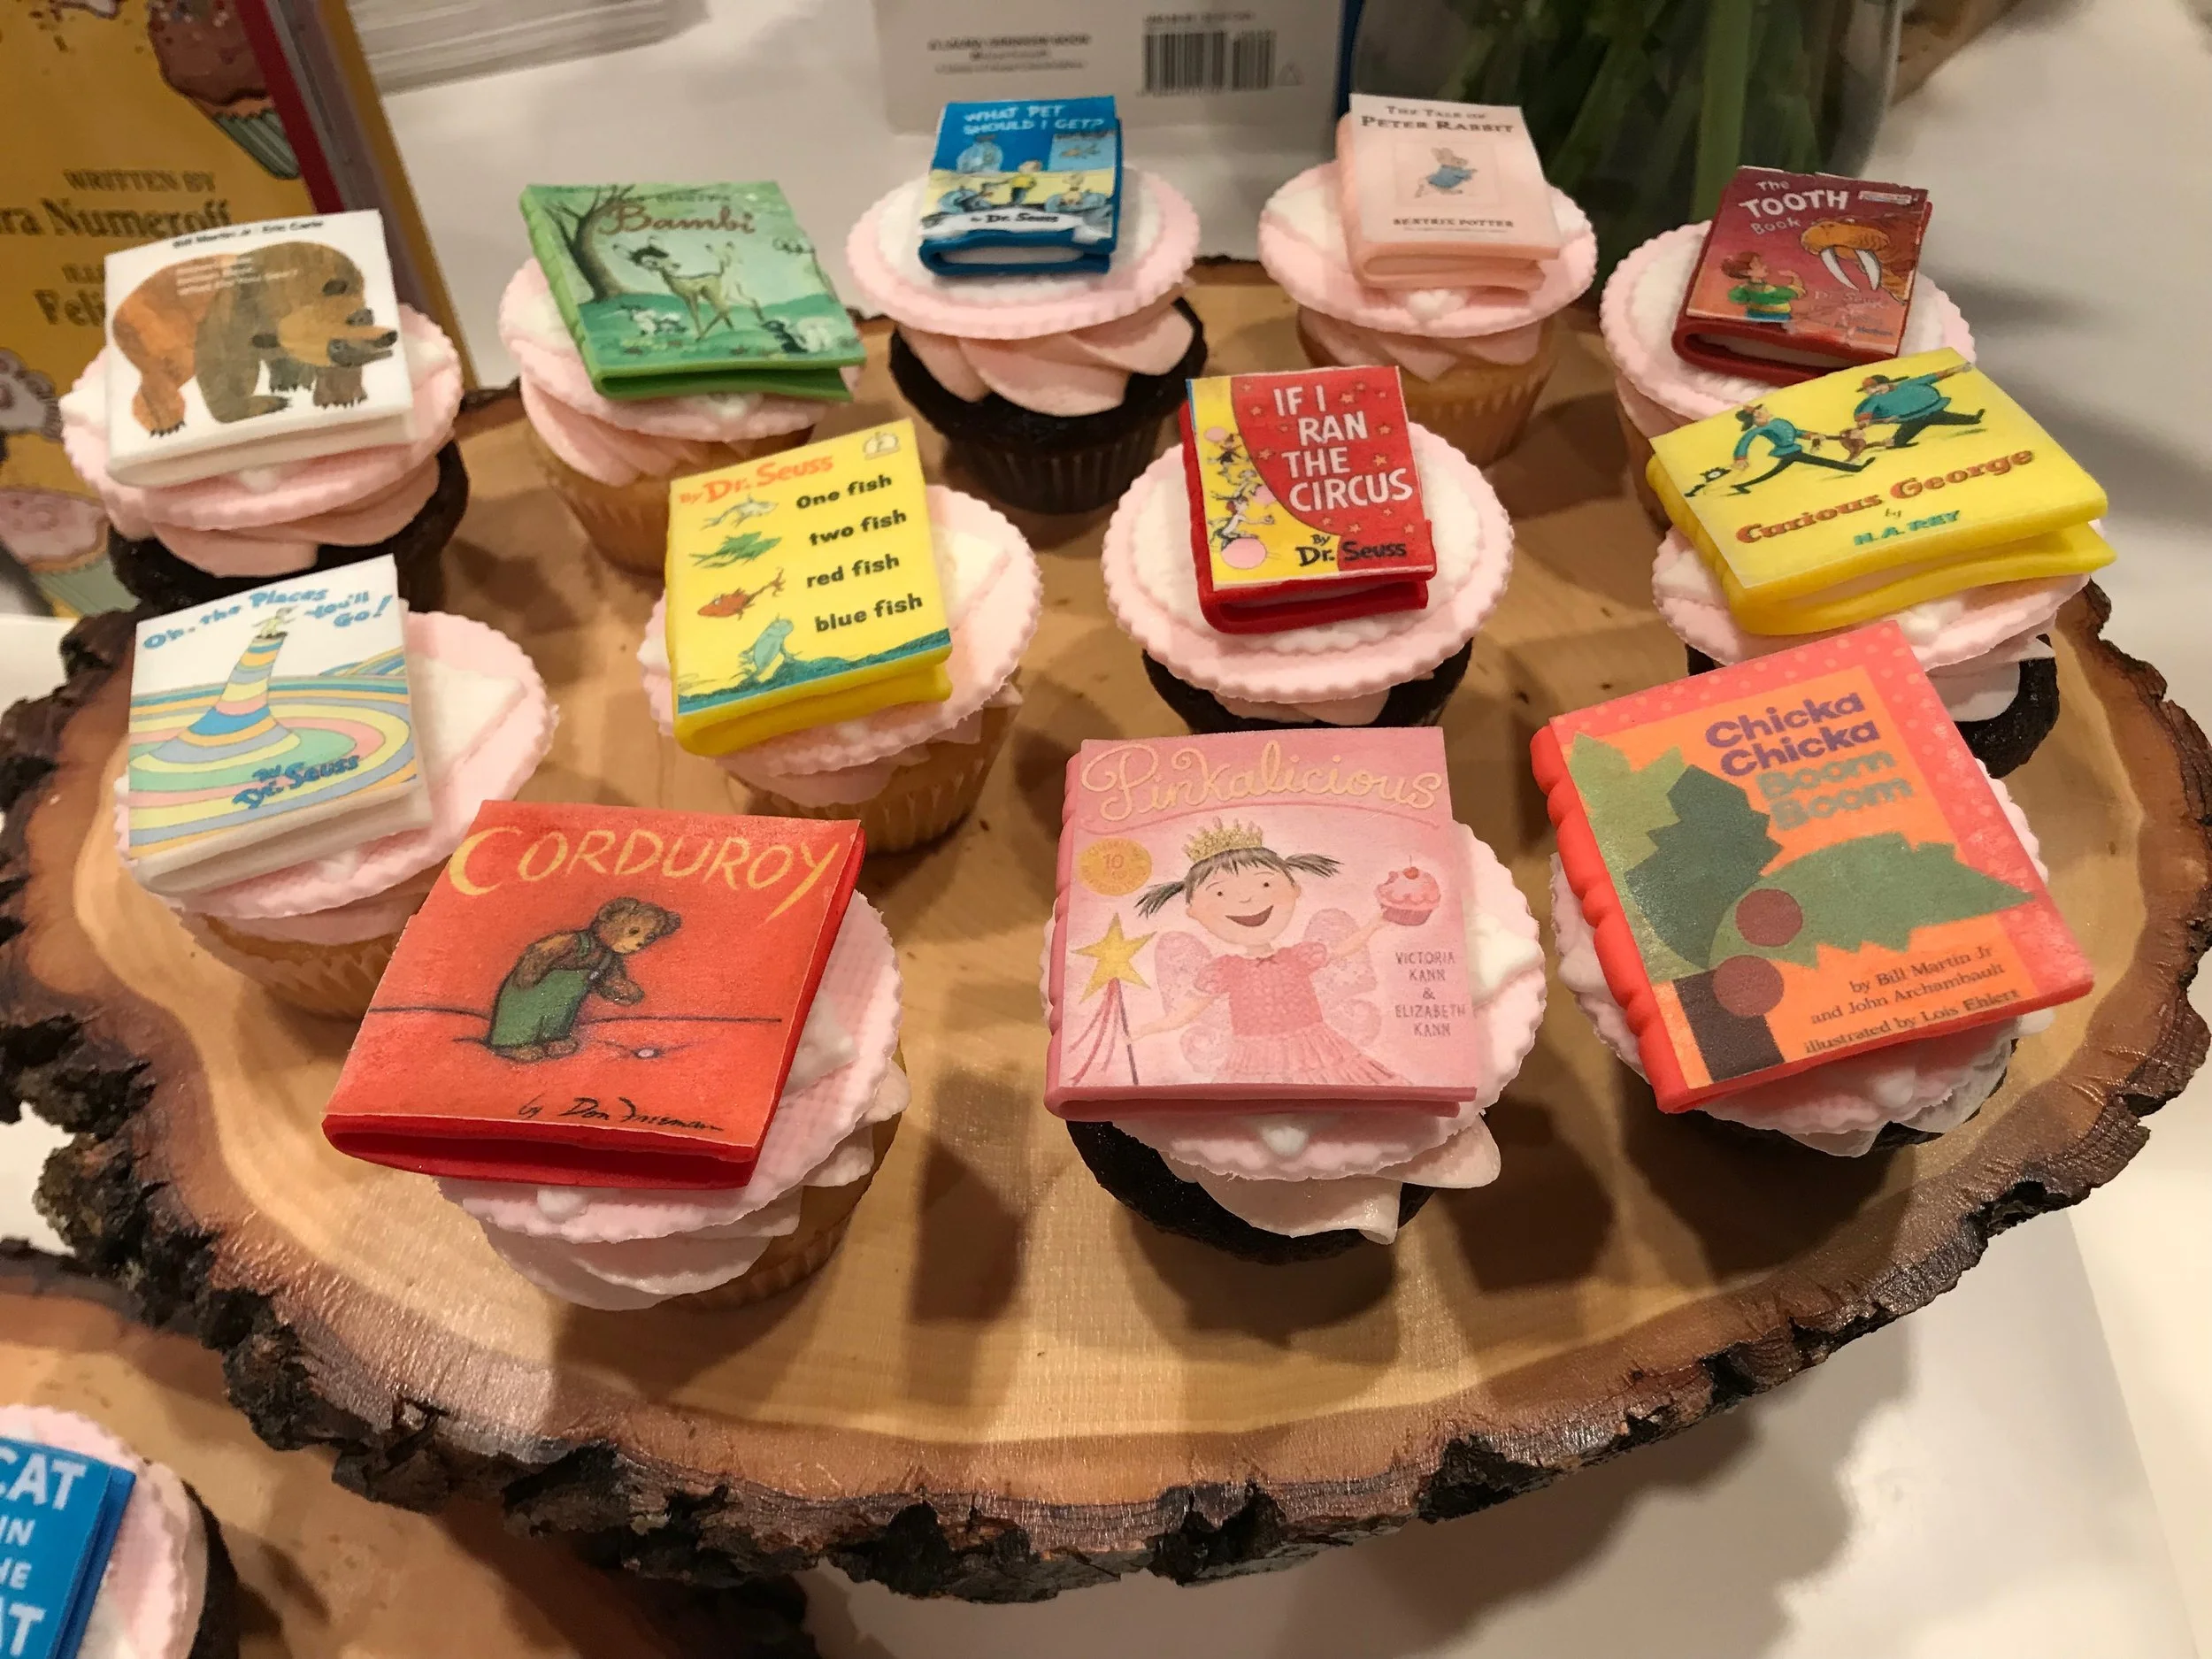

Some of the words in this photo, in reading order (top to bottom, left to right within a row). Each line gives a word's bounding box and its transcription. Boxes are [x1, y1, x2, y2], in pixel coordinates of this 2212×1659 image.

[963, 119, 1035, 134] SHOULD
[1041, 119, 1048, 130] I
[1054, 119, 1105, 129] GET?
[964, 106, 1018, 121] WHAT
[1027, 104, 1065, 119] PET
[1361, 115, 1428, 129] PETER
[1436, 120, 1514, 133] RABBIT
[63, 168, 180, 193] WRITTEN
[181, 170, 216, 193] BY
[1755, 180, 1791, 191] The
[41, 197, 231, 236] Numeroff
[598, 203, 757, 236] Bambi
[1017, 212, 1059, 222] Seuss
[1738, 189, 1849, 219] TOOTH
[1750, 217, 1801, 235] Book
[1272, 386, 1303, 417] IF
[1316, 384, 1326, 412] I
[1298, 410, 1369, 446] RAN
[1281, 446, 1351, 479] THE
[680, 492, 703, 503] By
[703, 479, 751, 503] Dr.
[757, 456, 834, 487] Seuss
[795, 490, 841, 511] One
[847, 474, 893, 497] fish
[1288, 468, 1414, 512] CIRCUS
[1735, 494, 1883, 543] Curious
[1890, 449, 2034, 500] George
[809, 525, 855, 547] two
[860, 509, 908, 533] fish
[1906, 510, 1961, 532] REY
[1295, 545, 1336, 567] Dr.
[1341, 541, 1408, 562] Seuss
[1310, 534, 1332, 546] By
[806, 565, 844, 588] red
[851, 553, 901, 577] fish
[199, 605, 242, 625] the
[250, 588, 329, 609] Places
[334, 594, 393, 628] Go!
[814, 608, 868, 633] blue
[873, 593, 923, 618] fish
[1705, 692, 1866, 749] Chicka
[1720, 719, 1881, 777] Chicka
[232, 780, 285, 810] Dr.
[285, 755, 360, 790] Seuss
[1080, 739, 1442, 823] Pinkalicious
[1756, 749, 1897, 799] Boom
[1770, 777, 1914, 831] Boom
[447, 825, 839, 926] CORDUROY
[1102, 853, 1125, 870] 10
[1395, 950, 1455, 966] VICTORIA
[1849, 979, 1871, 995] by
[1875, 969, 1907, 987] Bill
[1910, 952, 1971, 979] Martin
[1409, 968, 1446, 982] KANN
[1422, 987, 1436, 1000] &
[1809, 1004, 1844, 1025] and
[1848, 996, 1889, 1015] John
[1893, 963, 2006, 1003] Archambault
[1394, 1003, 1466, 1019] ELIZABETH
[1804, 1019, 1892, 1055] illustrated
[1895, 1013, 1917, 1029] by
[1920, 1004, 1960, 1024] Lois
[1962, 987, 2021, 1012] Ehlert
[1414, 1022, 1451, 1038] KANN
[518, 1090, 547, 1120] by
[557, 1096, 611, 1121] Don
